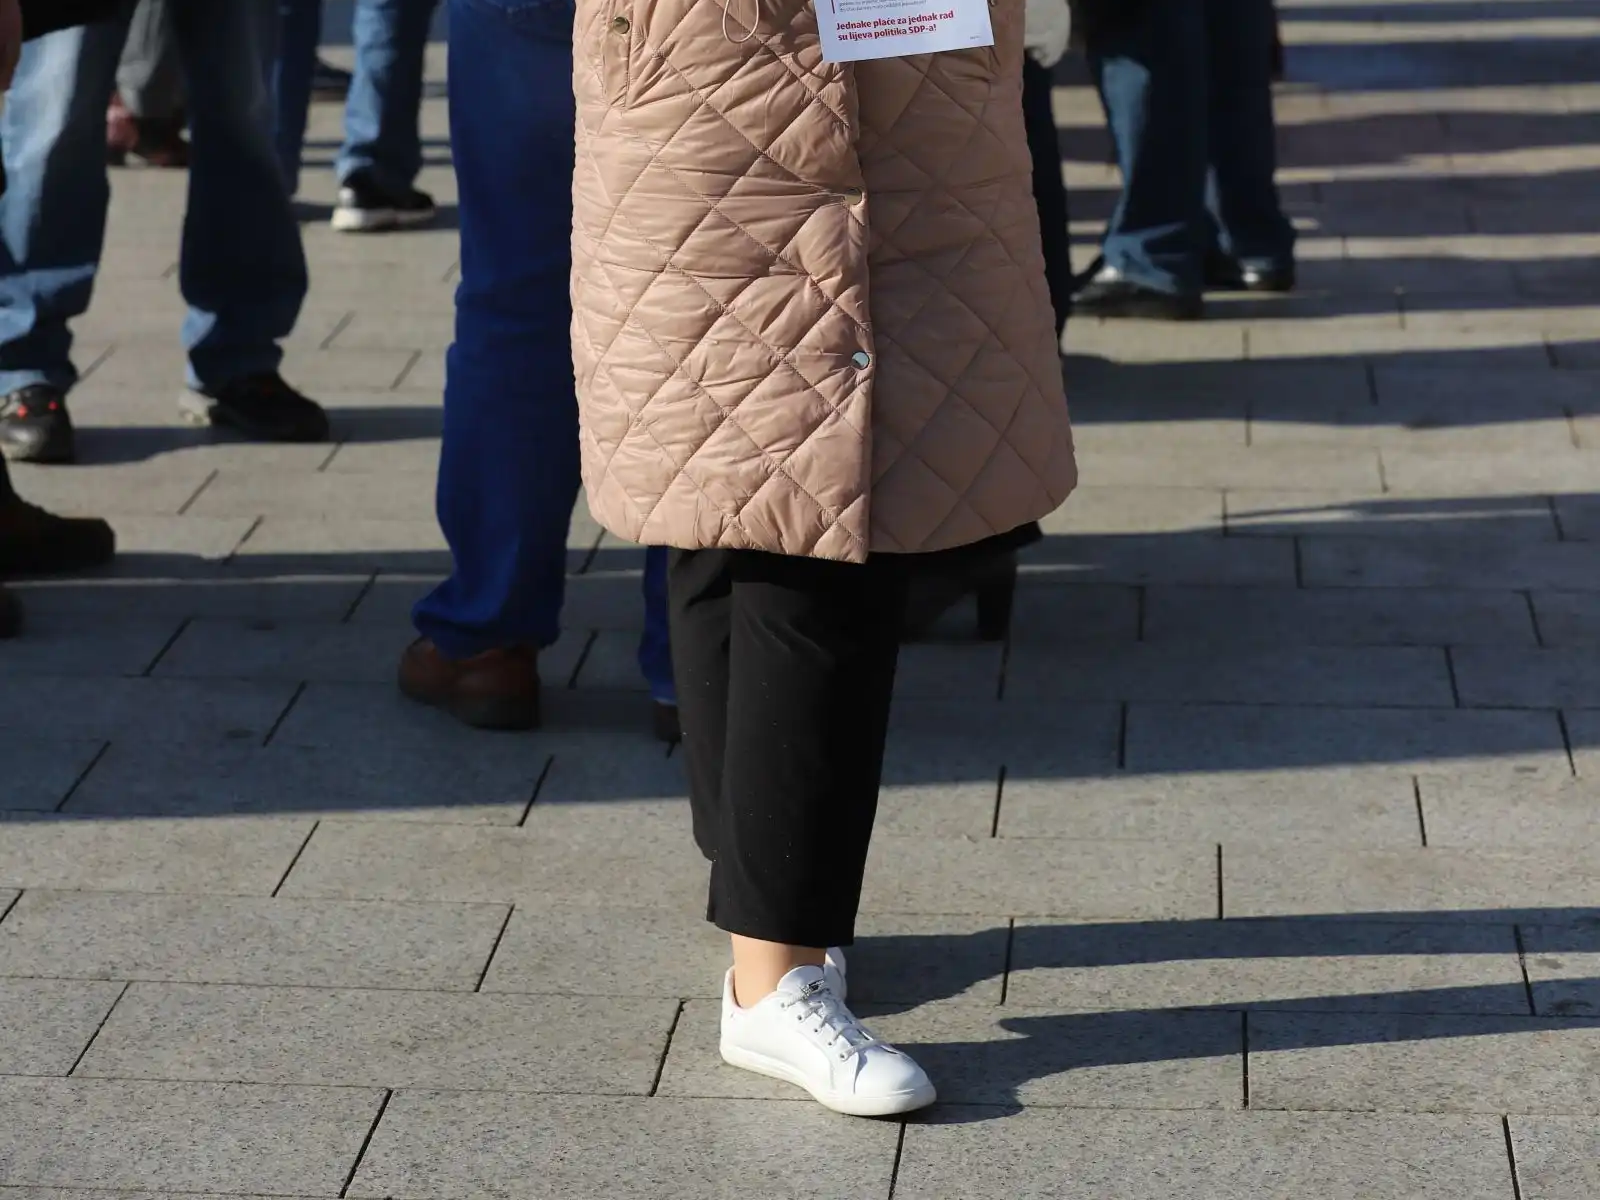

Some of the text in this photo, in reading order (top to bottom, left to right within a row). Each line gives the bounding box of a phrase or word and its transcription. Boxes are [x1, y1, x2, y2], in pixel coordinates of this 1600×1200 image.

[837, 10, 954, 31] Jednake plaće za jednak rad
[838, 22, 937, 42] su lijeva politika SDP-a!
